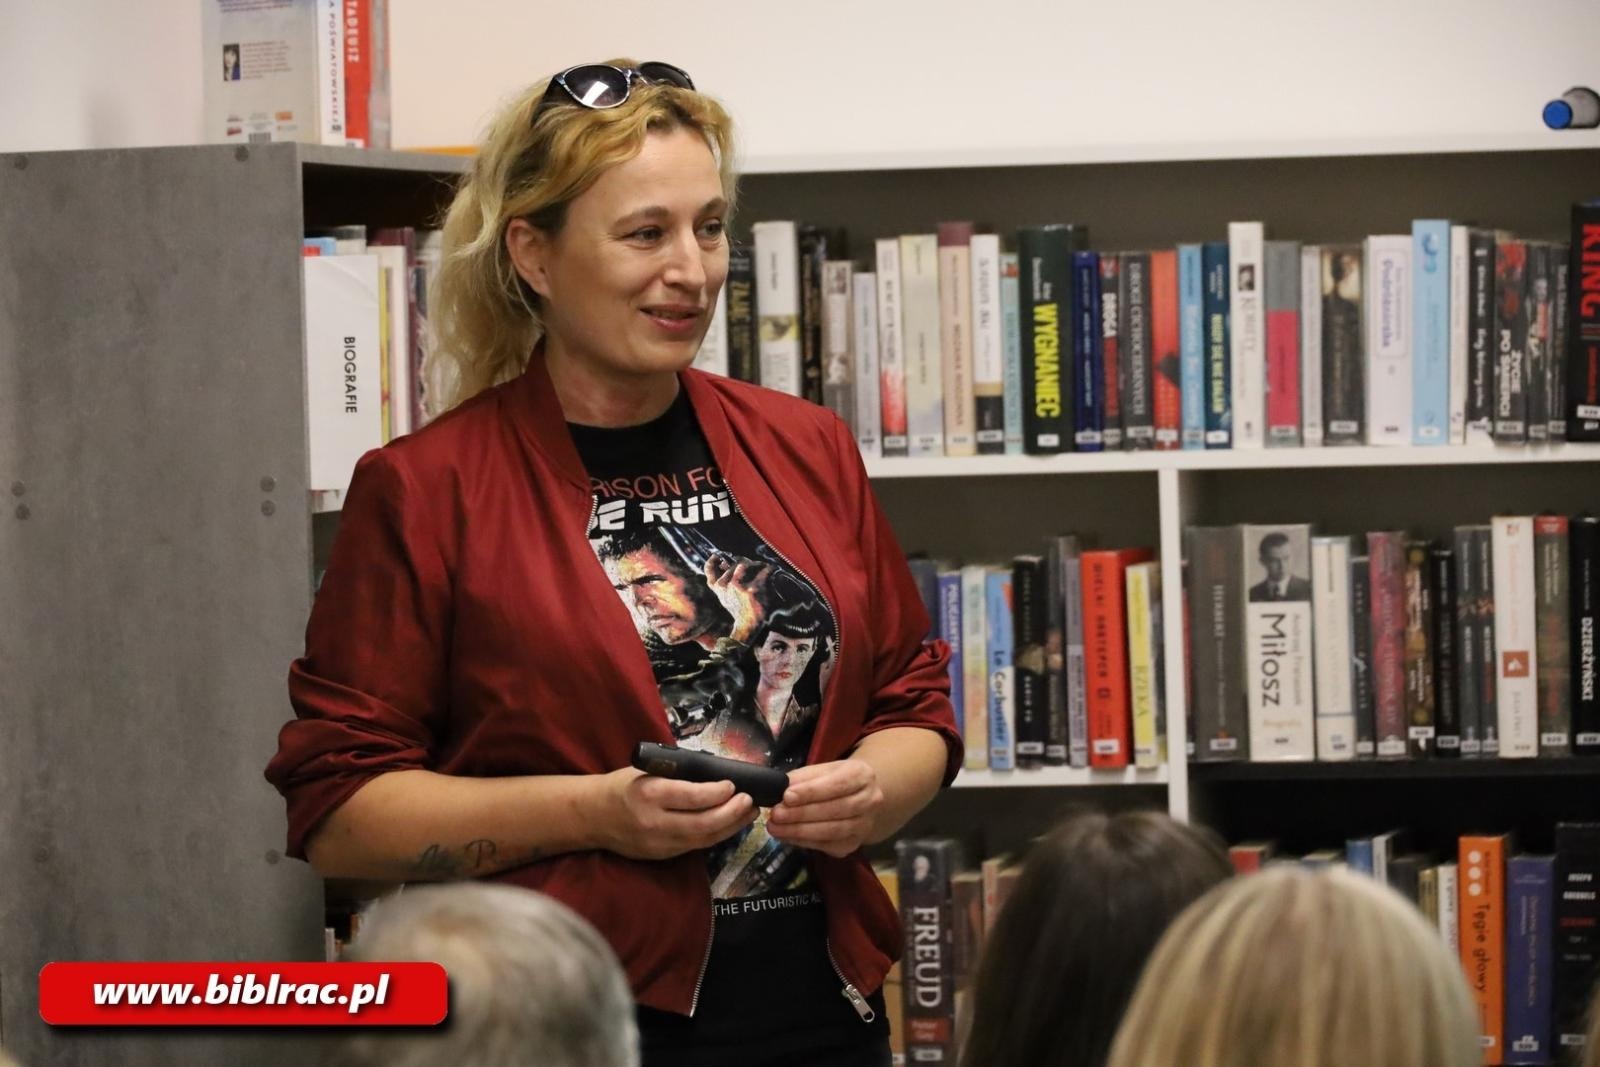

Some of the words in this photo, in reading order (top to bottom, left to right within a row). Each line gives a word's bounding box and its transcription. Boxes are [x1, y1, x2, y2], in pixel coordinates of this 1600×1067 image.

[1581, 224, 1600, 317] KING
[1102, 292, 1118, 338] DROGA
[1500, 329, 1511, 353] PO
[343, 336, 358, 413] BIOGRAFIE
[1033, 303, 1061, 418] WYGNANIEC
[994, 650, 1006, 666] Le
[1261, 613, 1287, 708] Miłosz
[1581, 616, 1597, 700] DZIERŻYŃSKI
[994, 671, 1009, 742] Corbusier
[714, 902, 740, 917] THE
[743, 895, 809, 913] FUTURISTIC
[1472, 903, 1491, 943] Tęgie
[914, 906, 942, 1008] FREUD
[1474, 946, 1491, 992] głowy
